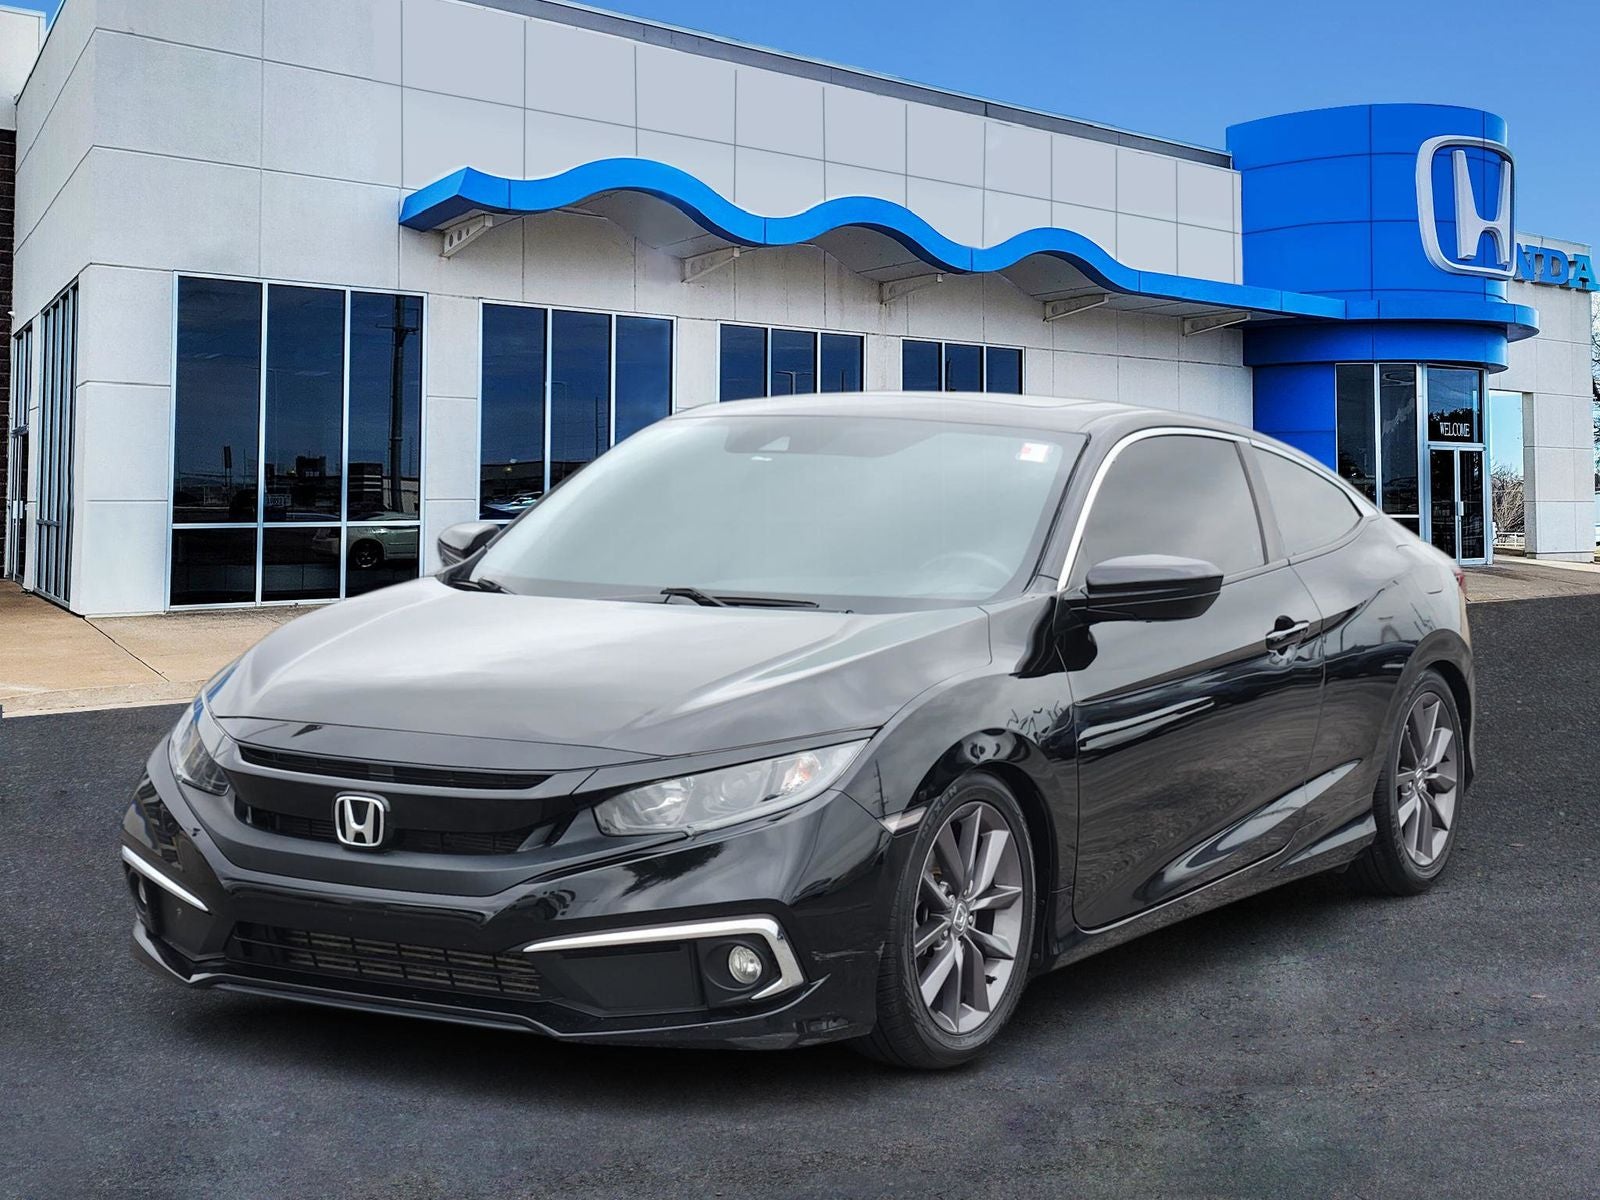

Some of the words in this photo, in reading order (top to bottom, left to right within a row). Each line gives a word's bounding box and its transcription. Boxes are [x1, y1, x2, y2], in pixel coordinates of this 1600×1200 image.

[1513, 243, 1600, 291] NDA
[1439, 421, 1470, 437] WELCOME
[343, 798, 375, 845] H
